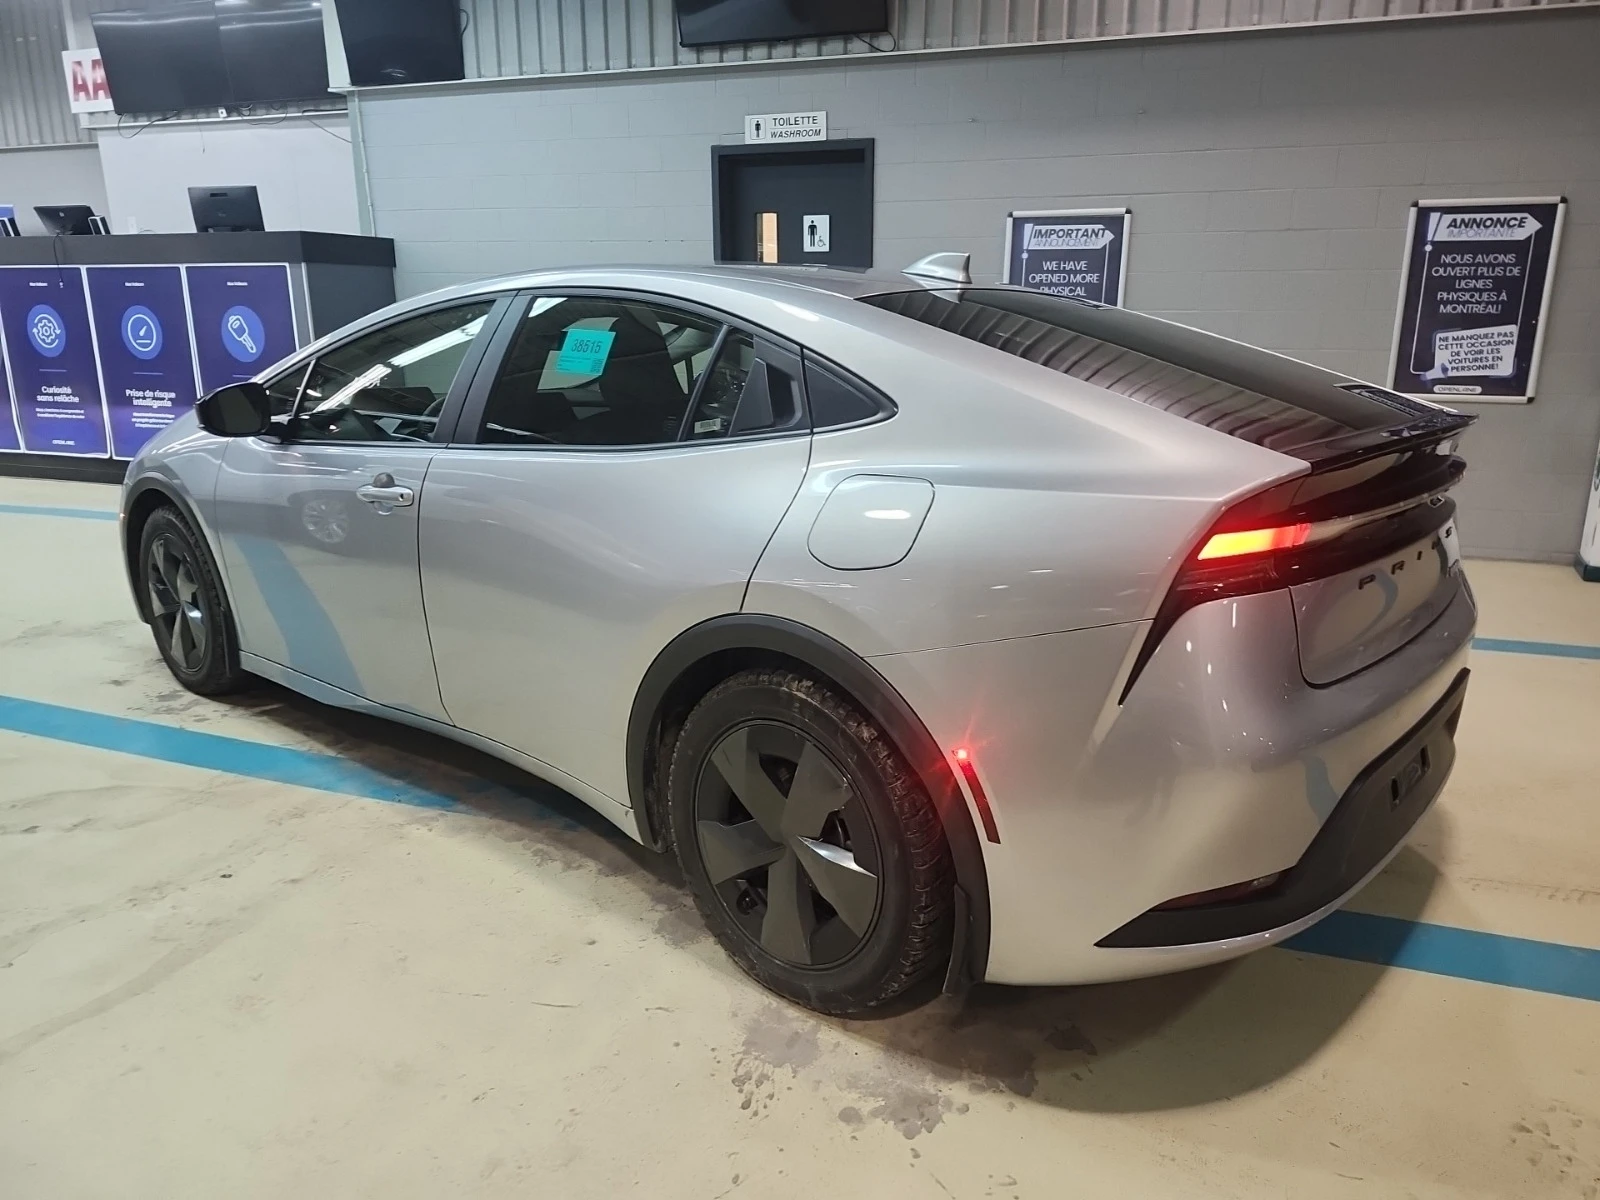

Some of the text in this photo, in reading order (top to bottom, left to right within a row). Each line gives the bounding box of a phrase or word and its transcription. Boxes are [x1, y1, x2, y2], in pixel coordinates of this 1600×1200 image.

[772, 116, 818, 126] TOILETTE
[770, 129, 821, 138] WASHROOM
[1447, 217, 1528, 229] ANNONCE
[1033, 228, 1107, 239] IMPORTANT
[1447, 228, 1516, 238] IMPORTANTE
[1034, 239, 1100, 247] ANNOUNCEMENT
[1440, 254, 1517, 264] NOUS AVONS
[1042, 261, 1088, 271] WE HAVE
[1432, 266, 1521, 276] OUVERT PLUS DE
[1029, 274, 1100, 283] OPENED MORE
[1455, 279, 1493, 289] LIGNES
[1437, 289, 1508, 302] PHYSIQUES À
[1439, 303, 1502, 314] MONTRÉAL!
[1451, 332, 1495, 342] MANQUEZ
[571, 338, 603, 354] 38515
[1438, 339, 1514, 350] CETTE OCCASION
[1464, 348, 1484, 356] VOIR
[1486, 347, 1501, 355] LES
[1447, 356, 1490, 365] VOITURES
[1450, 363, 1499, 372] PERSONNE!
[41, 385, 72, 394] Curiosité
[126, 389, 176, 400] Prise de risque
[132, 397, 172, 408] intelligente
